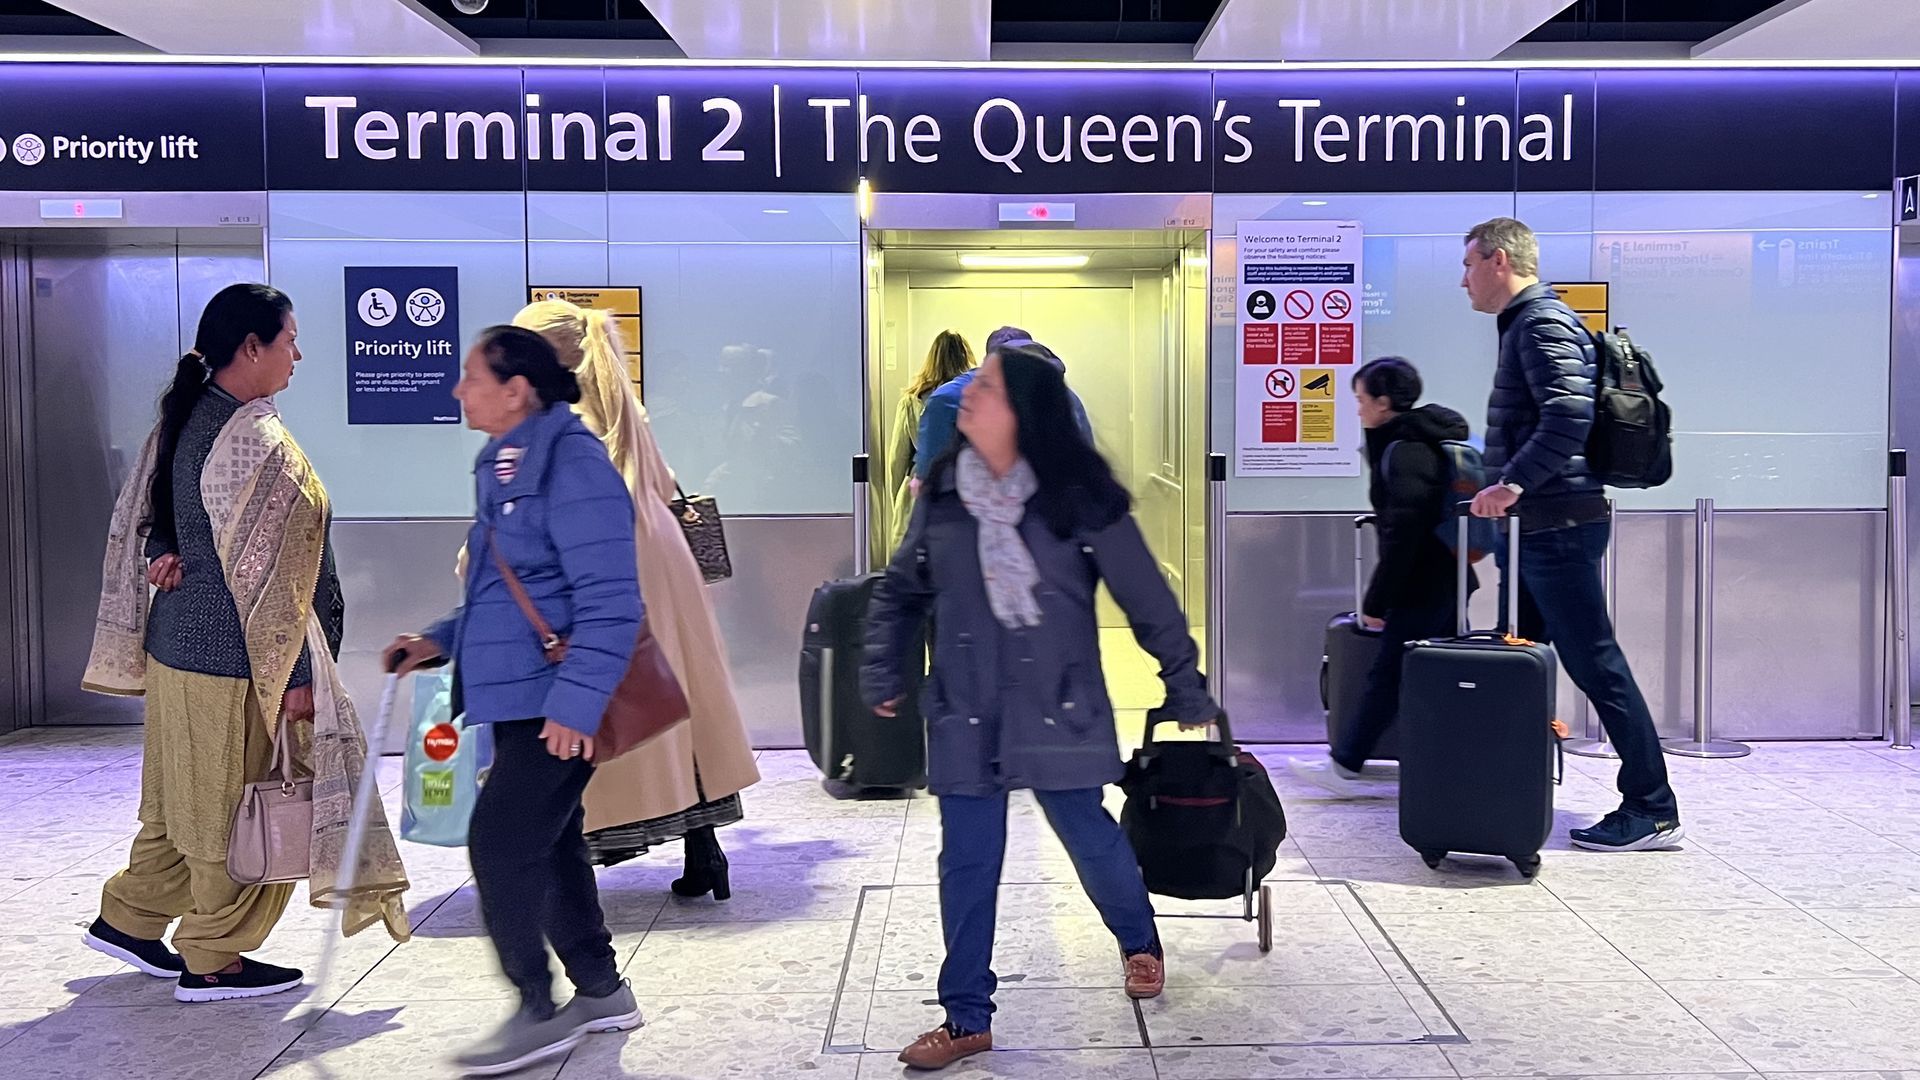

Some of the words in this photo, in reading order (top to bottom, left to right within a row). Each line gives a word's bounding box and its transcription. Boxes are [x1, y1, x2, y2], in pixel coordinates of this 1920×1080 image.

[304, 94, 672, 162] Terminal
[701, 97, 745, 161] 2
[807, 94, 941, 163] The
[973, 97, 1253, 173] Queen's
[1279, 93, 1573, 163] Terminal
[53, 134, 154, 165] Priority
[160, 135, 199, 159] lift
[1244, 235, 1284, 243] Welcome
[1286, 235, 1295, 243] to
[1297, 235, 1334, 243] Terminal
[1336, 235, 1342, 243] 2
[354, 340, 422, 360] Priority
[426, 340, 452, 356] lift
